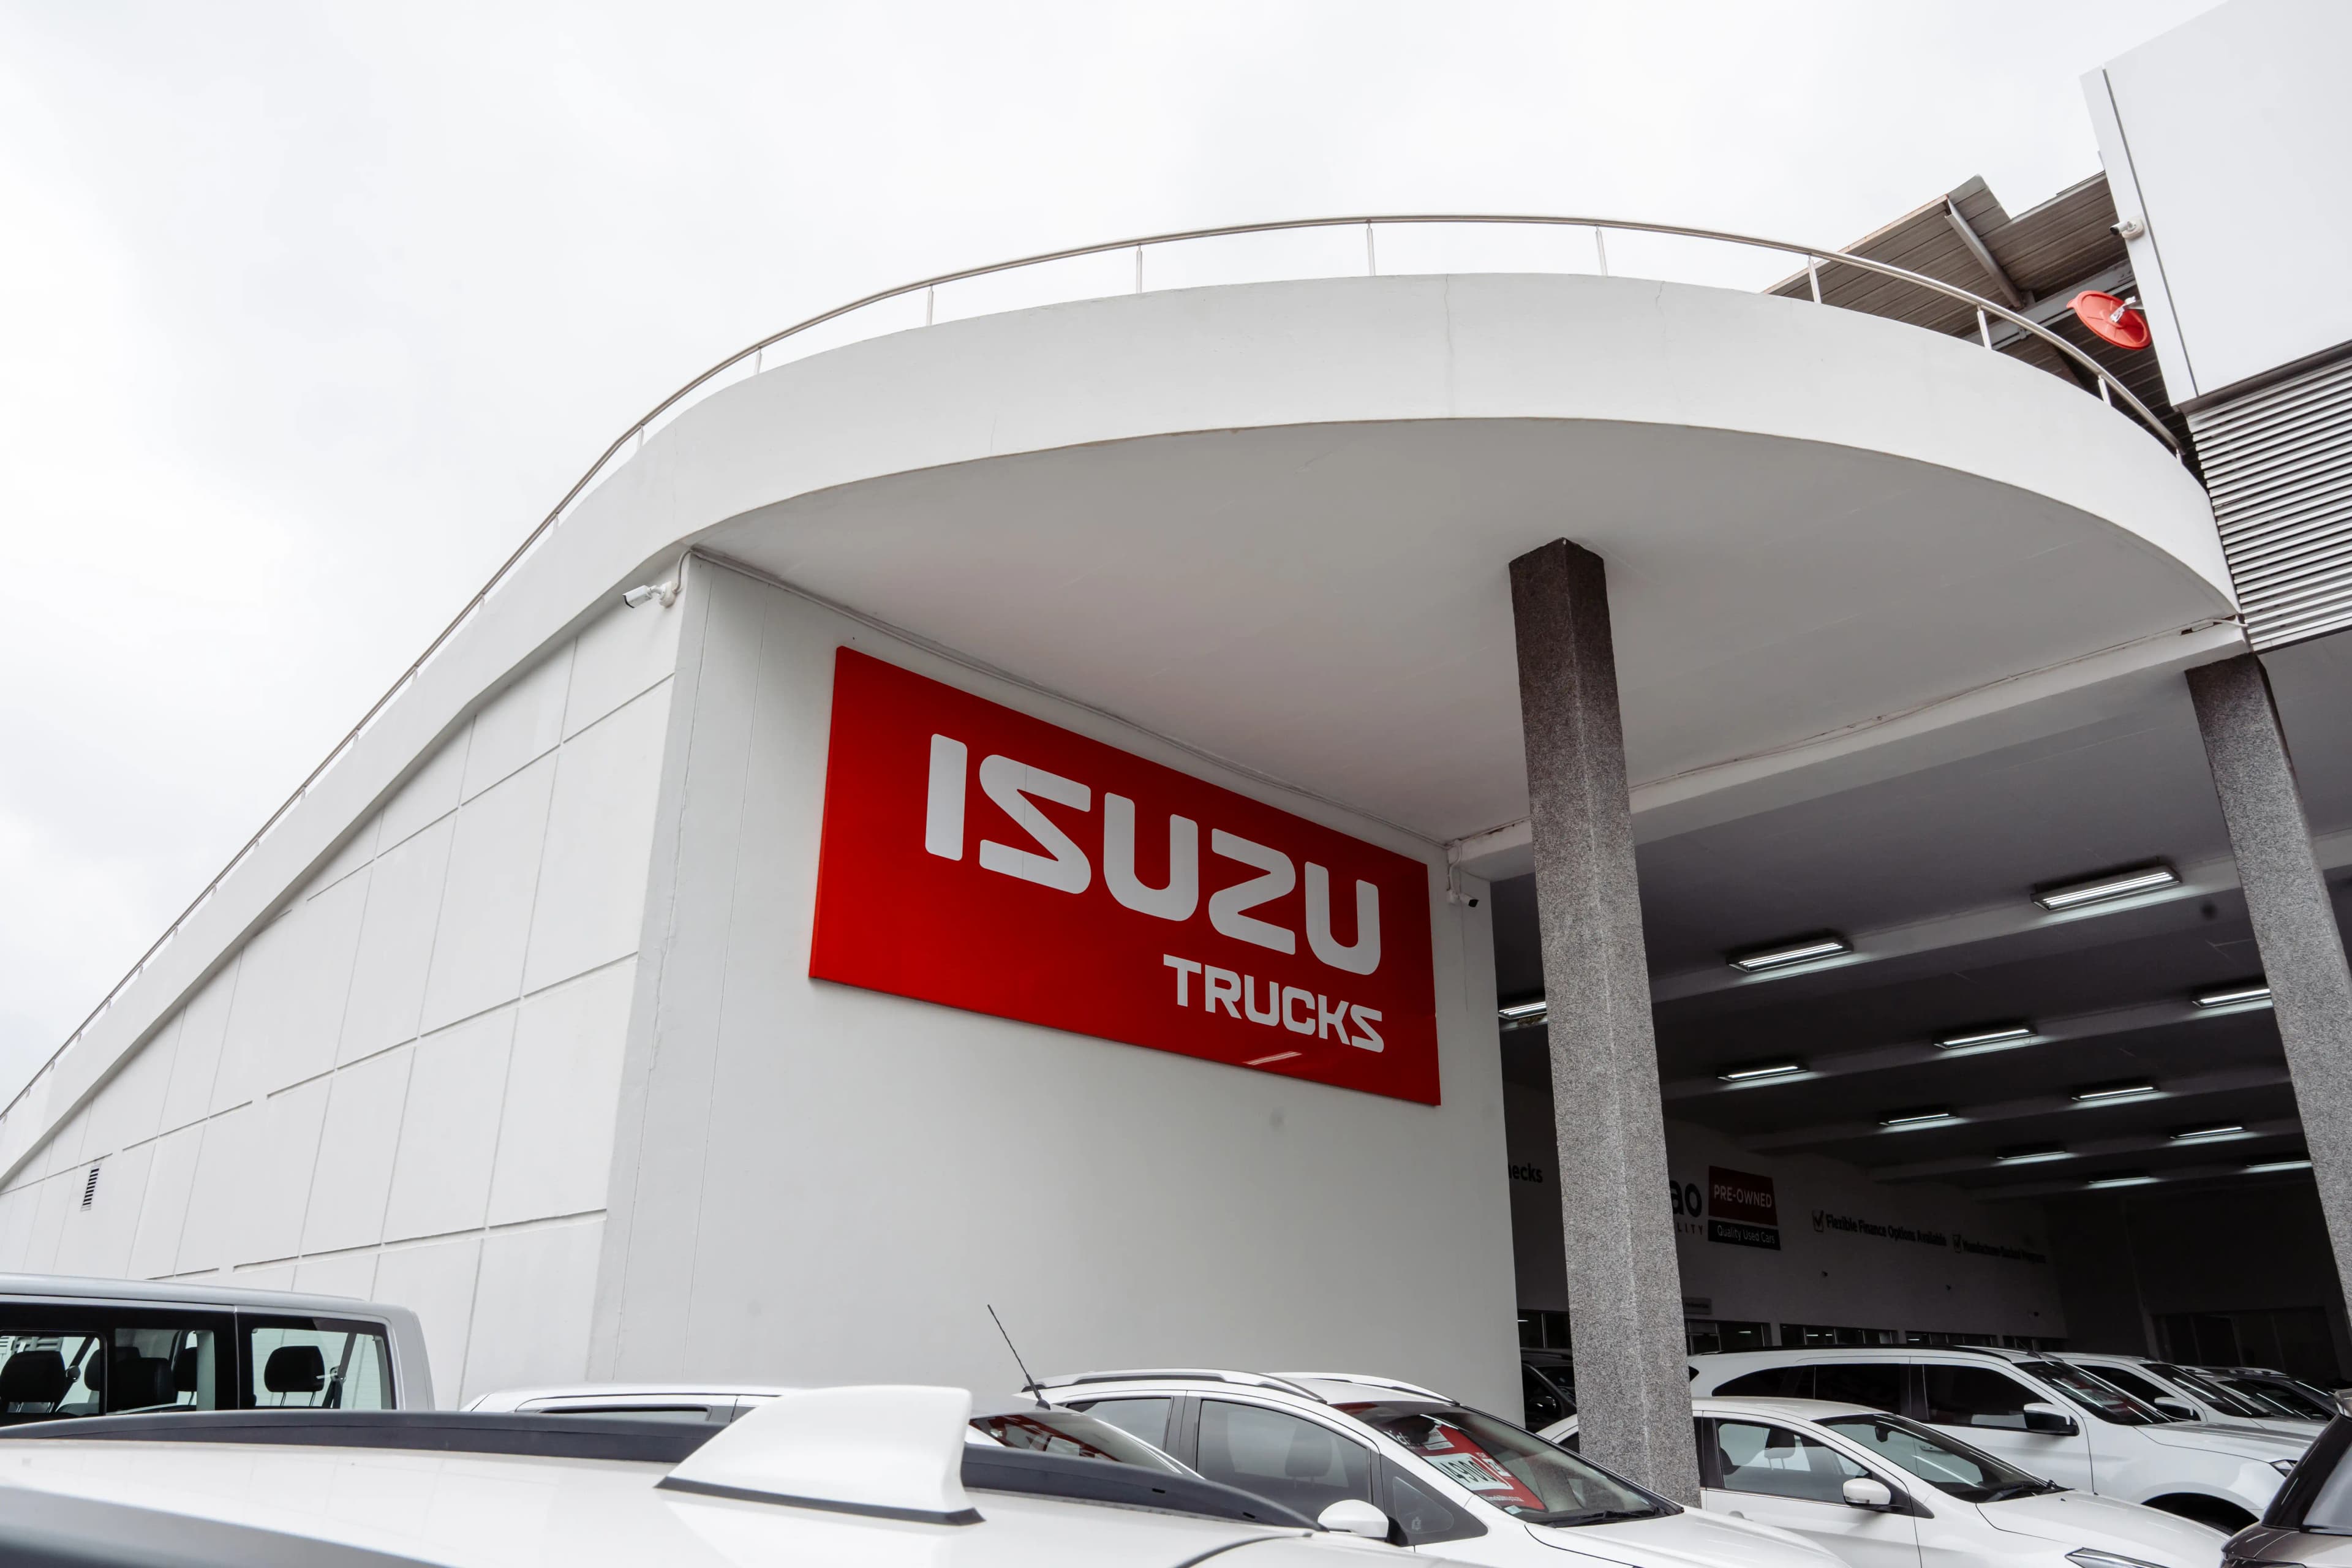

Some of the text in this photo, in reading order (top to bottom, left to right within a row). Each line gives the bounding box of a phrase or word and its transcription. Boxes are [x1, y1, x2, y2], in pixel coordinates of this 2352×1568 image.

[924, 733, 1381, 975] ISUZU
[1163, 954, 1384, 1052] TRUCKS
[1714, 1185, 1772, 1208] PRE-OWNED
[1717, 1224, 1775, 1244] Quality Used Cars
[1888, 1225, 1915, 1241] Options
